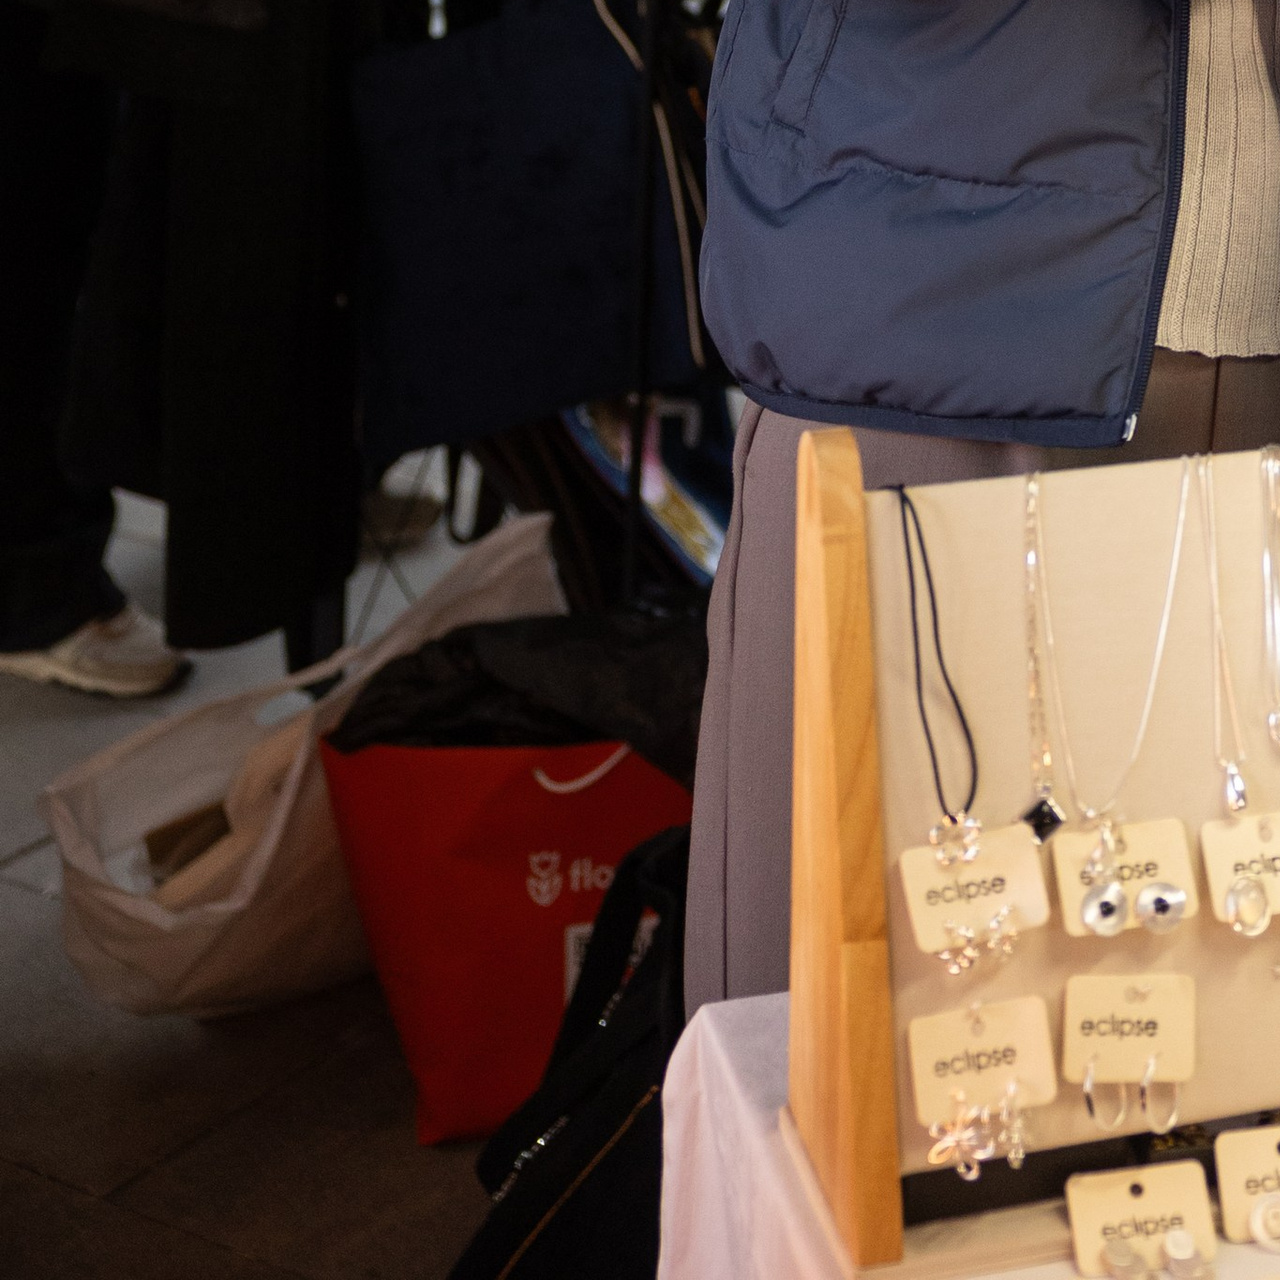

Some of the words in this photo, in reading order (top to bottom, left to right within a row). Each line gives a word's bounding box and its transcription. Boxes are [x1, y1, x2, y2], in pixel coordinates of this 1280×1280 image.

[1080, 860, 1159, 887] epse
[926, 875, 1006, 906] eclipse
[1080, 1013, 1159, 1040] eclipse
[934, 1047, 1017, 1077] eclipse
[1102, 1213, 1184, 1241] eclipse
